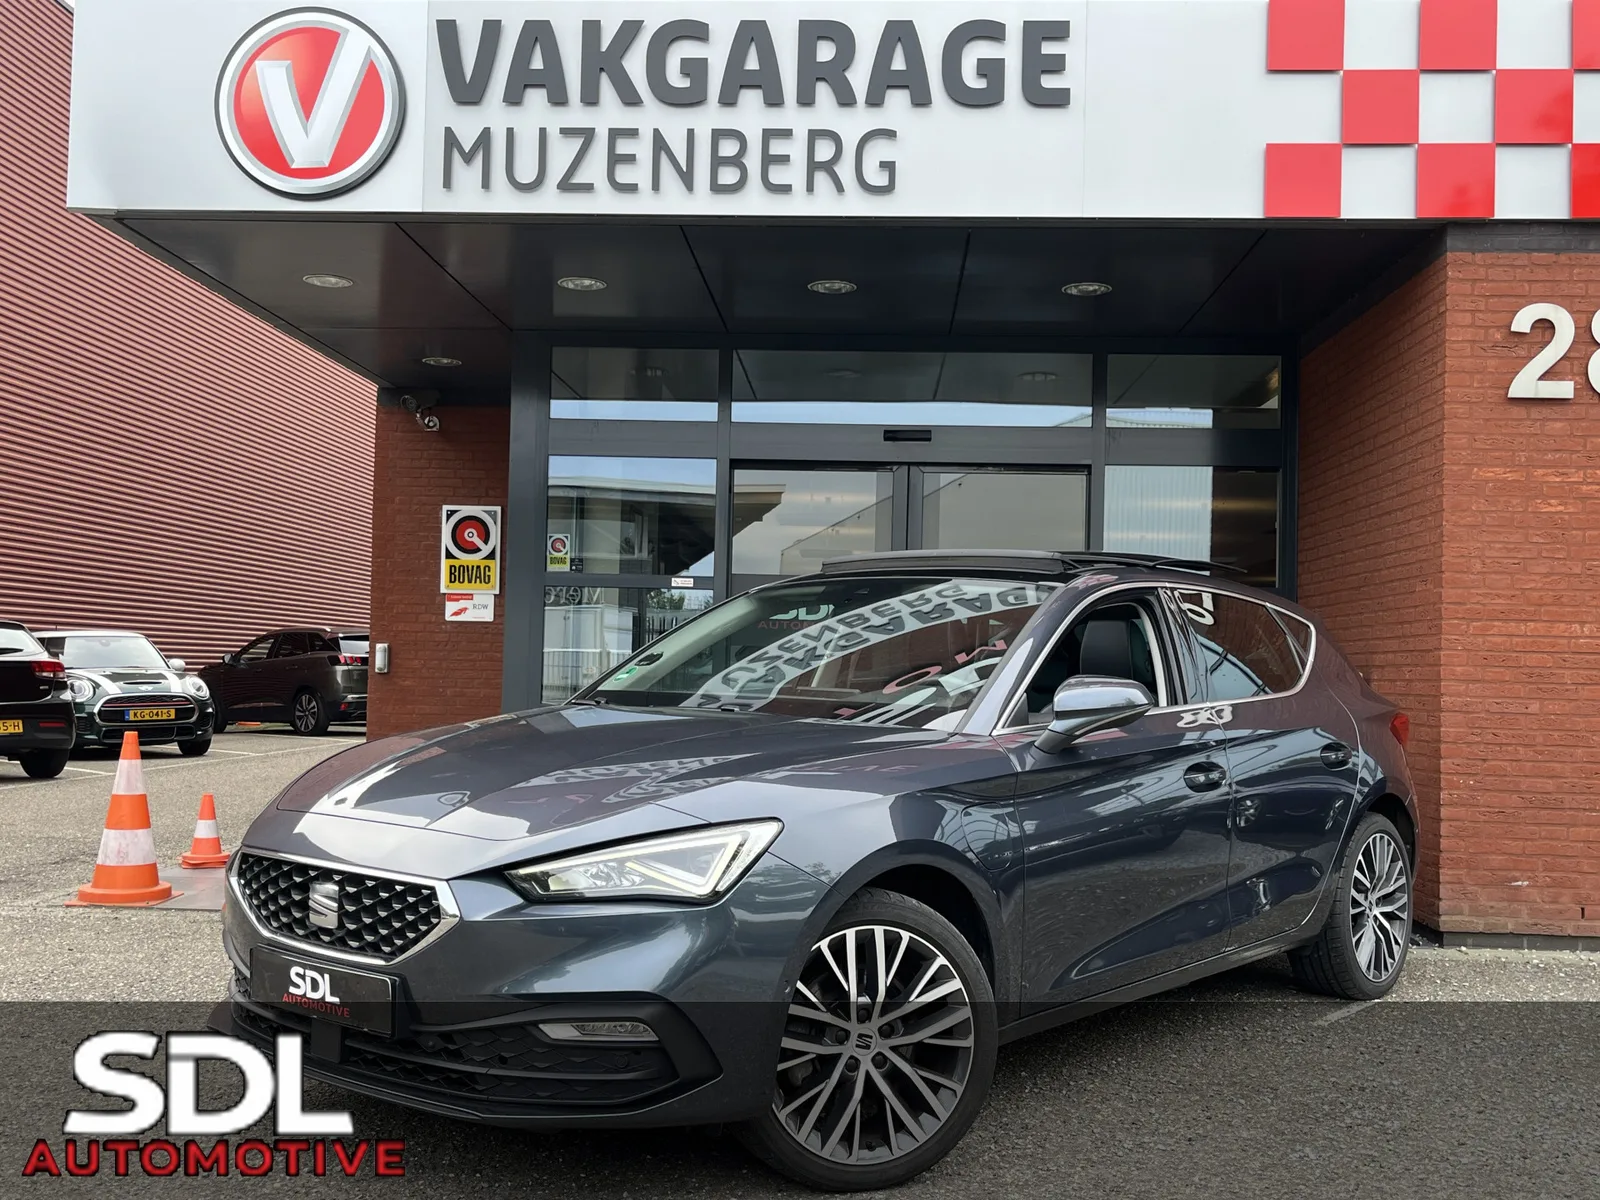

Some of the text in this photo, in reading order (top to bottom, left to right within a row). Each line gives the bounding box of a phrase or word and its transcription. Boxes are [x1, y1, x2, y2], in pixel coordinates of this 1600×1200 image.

[436, 19, 1071, 108] VAKGARAGE
[442, 126, 898, 196] MUZENBERG
[1508, 303, 1600, 399] 2
[549, 556, 567, 565] BOVAG
[449, 564, 491, 585] BOVAG
[472, 603, 489, 611] RDW
[133, 709, 173, 719] KG-041-S
[0, 721, 20, 732] 5-H
[289, 965, 341, 1004] SDL
[282, 992, 350, 1018] AUTOMOTIVE
